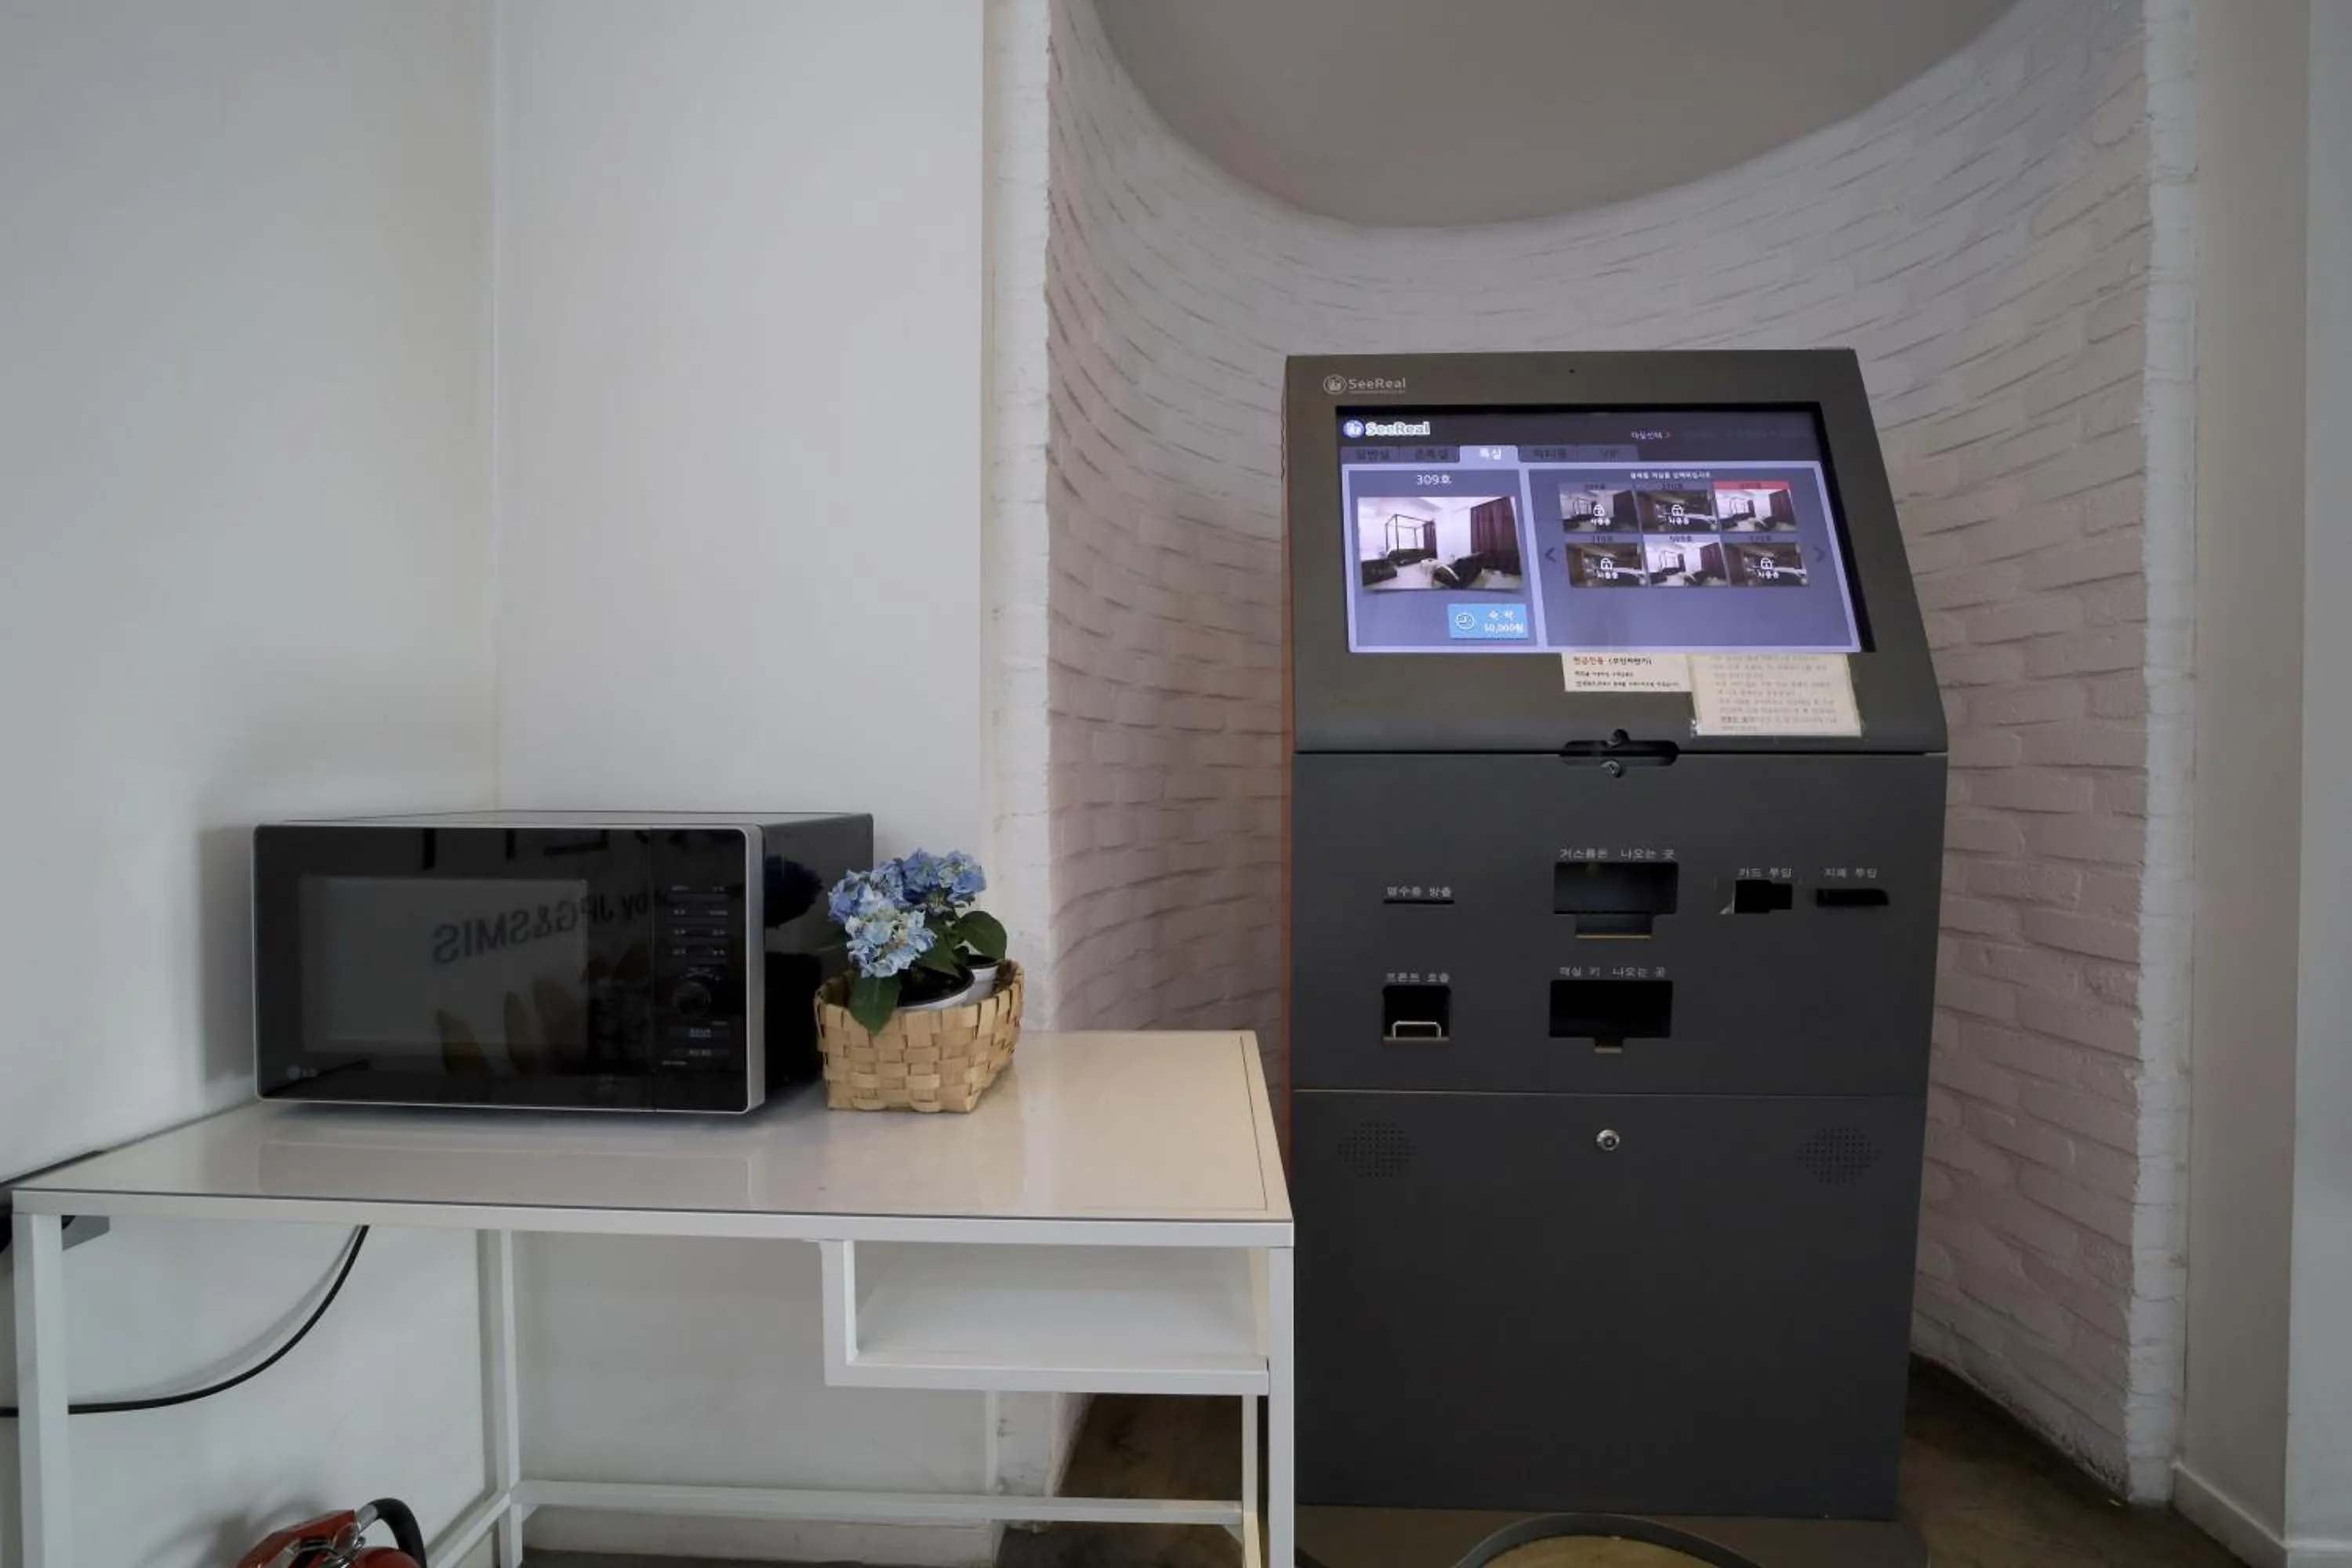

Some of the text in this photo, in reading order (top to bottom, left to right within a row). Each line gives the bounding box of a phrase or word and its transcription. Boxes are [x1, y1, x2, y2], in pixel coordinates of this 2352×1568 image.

[1348, 377, 1406, 390] SeeReal
[1365, 421, 1431, 437] SeeReal
[1416, 474, 1452, 485] 309호
[1559, 848, 1676, 861] 거스름돈 나오는 곳
[1737, 865, 1793, 879] 카드 투입
[1855, 866, 1878, 879] 투입
[1559, 965, 1666, 978] 객실 키 나오는 곳
